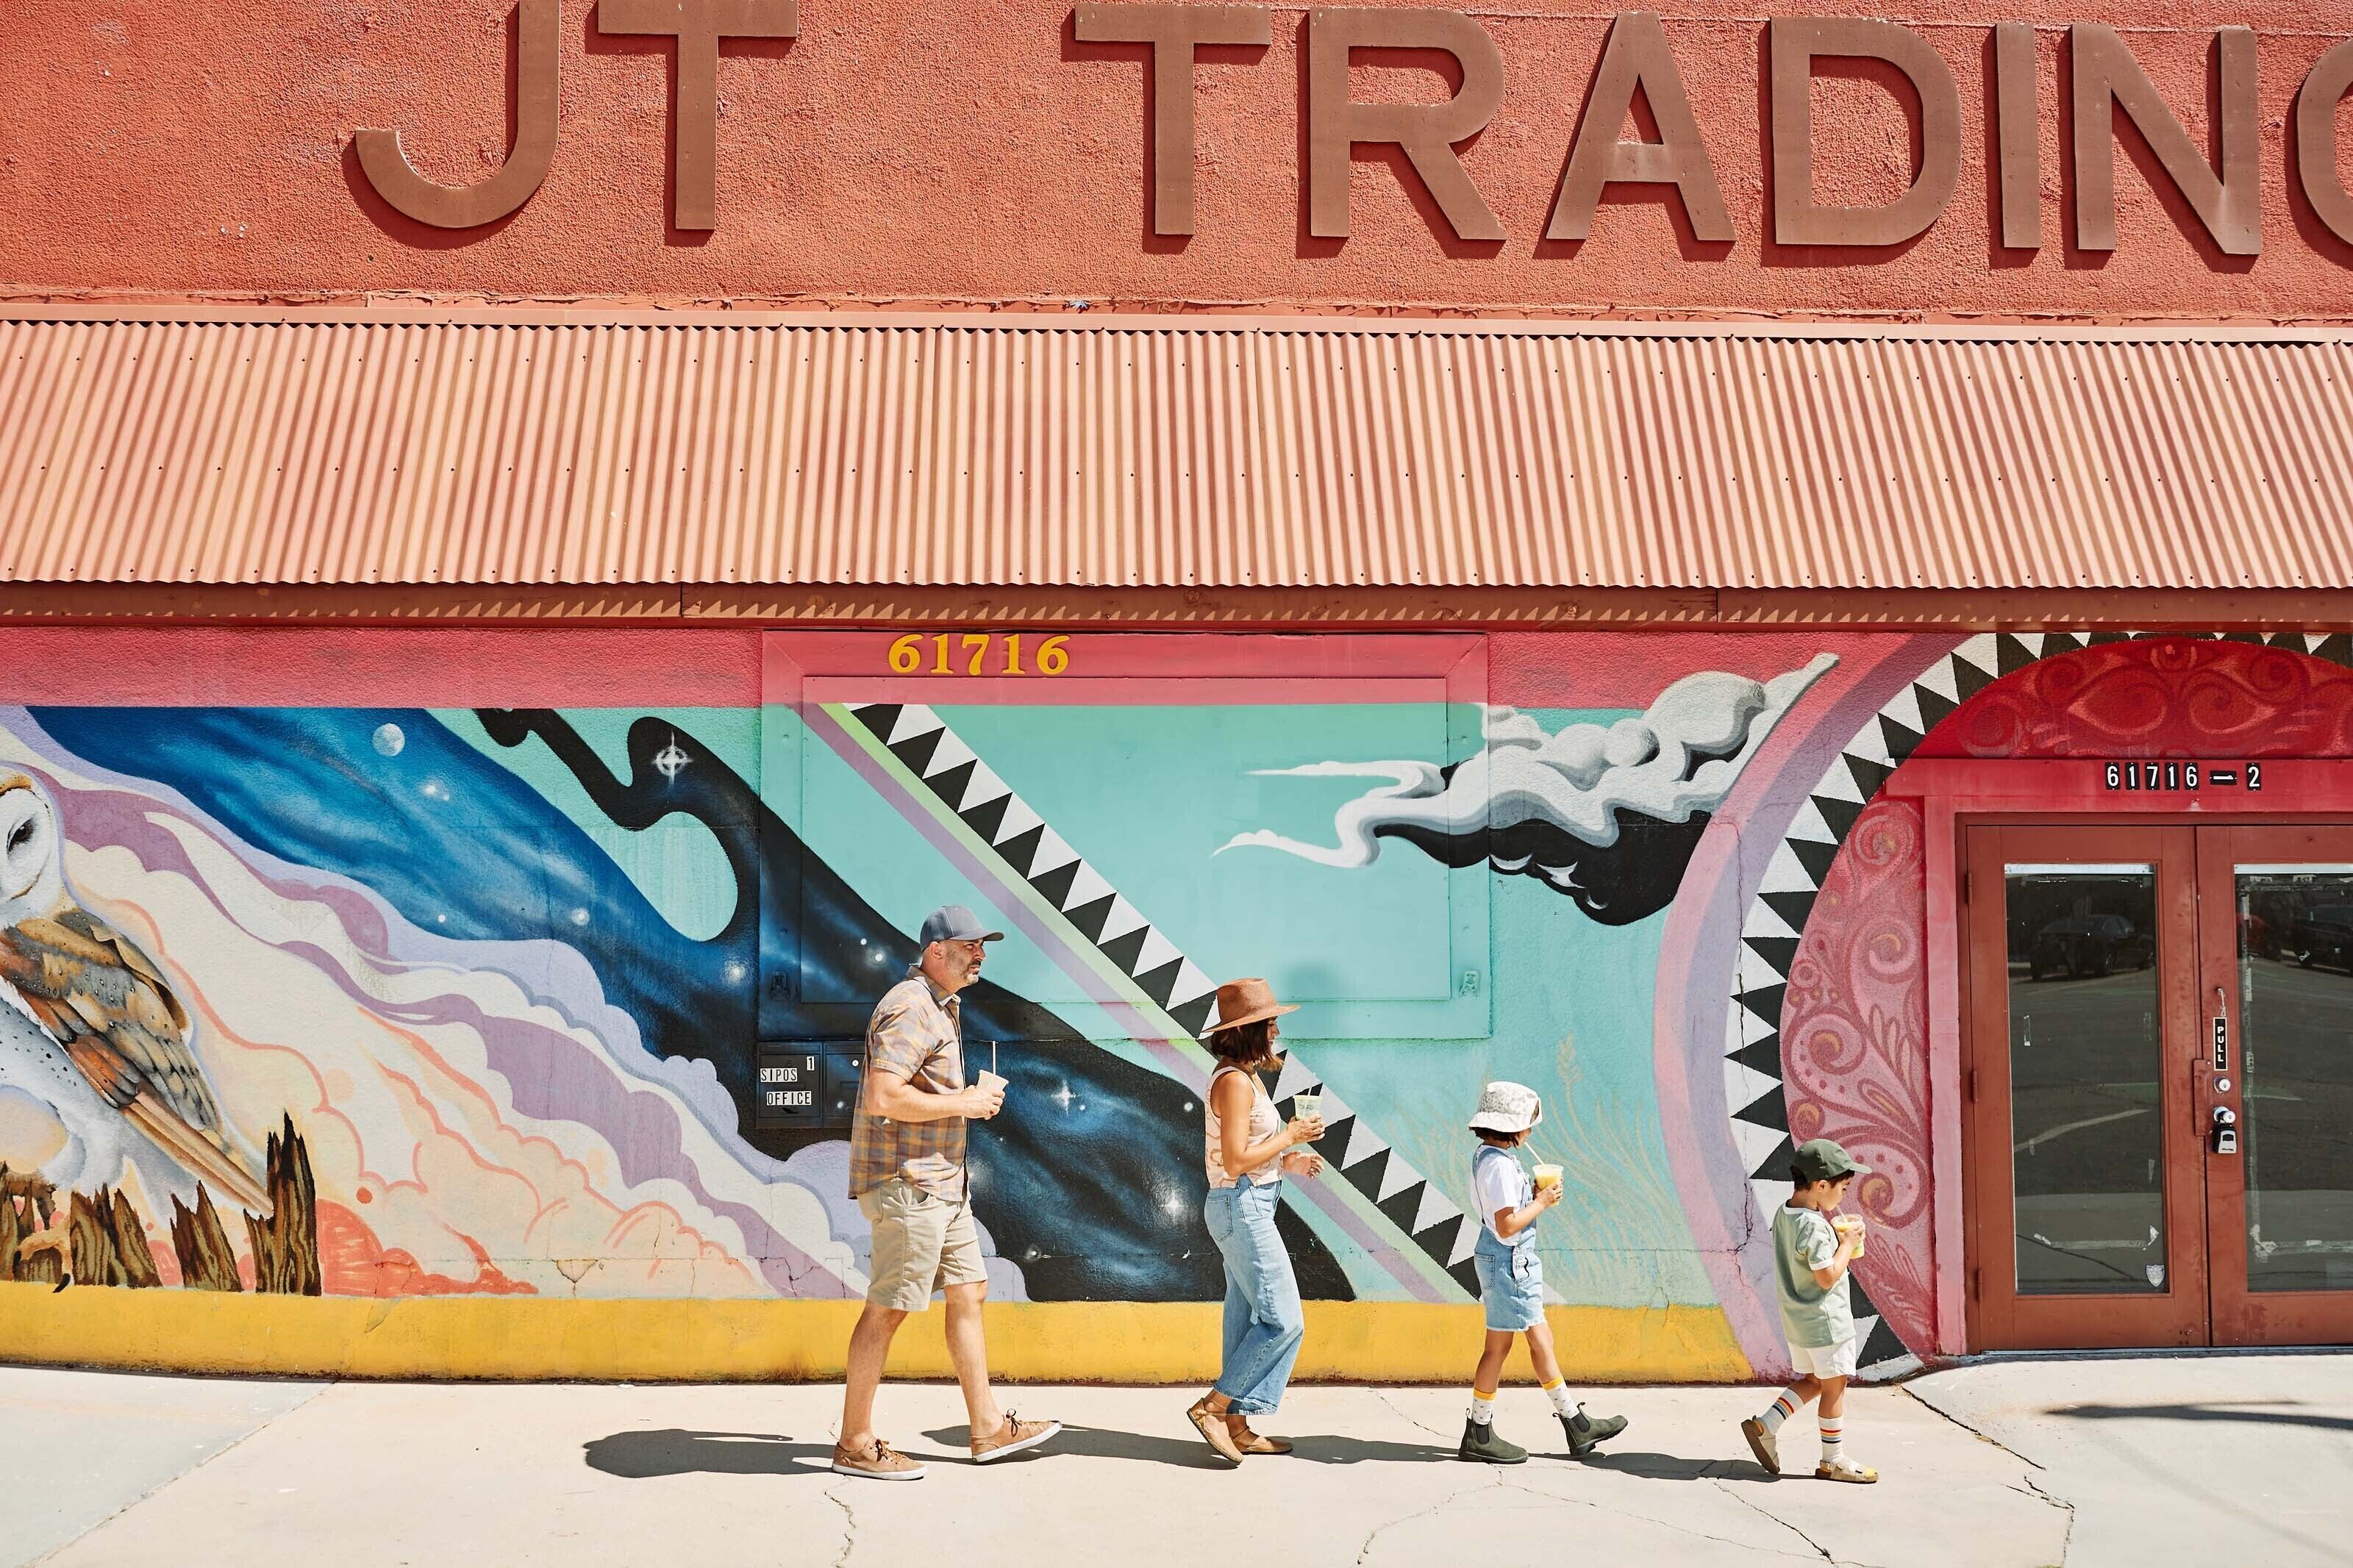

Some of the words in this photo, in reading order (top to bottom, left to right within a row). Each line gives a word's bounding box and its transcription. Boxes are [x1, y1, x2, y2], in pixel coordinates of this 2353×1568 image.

[355, 0, 798, 229] JT
[888, 634, 1070, 676] 61716
[807, 1057, 813, 1070] 1
[760, 1069, 796, 1081] SIPOS
[767, 1092, 810, 1105] OFFICE
